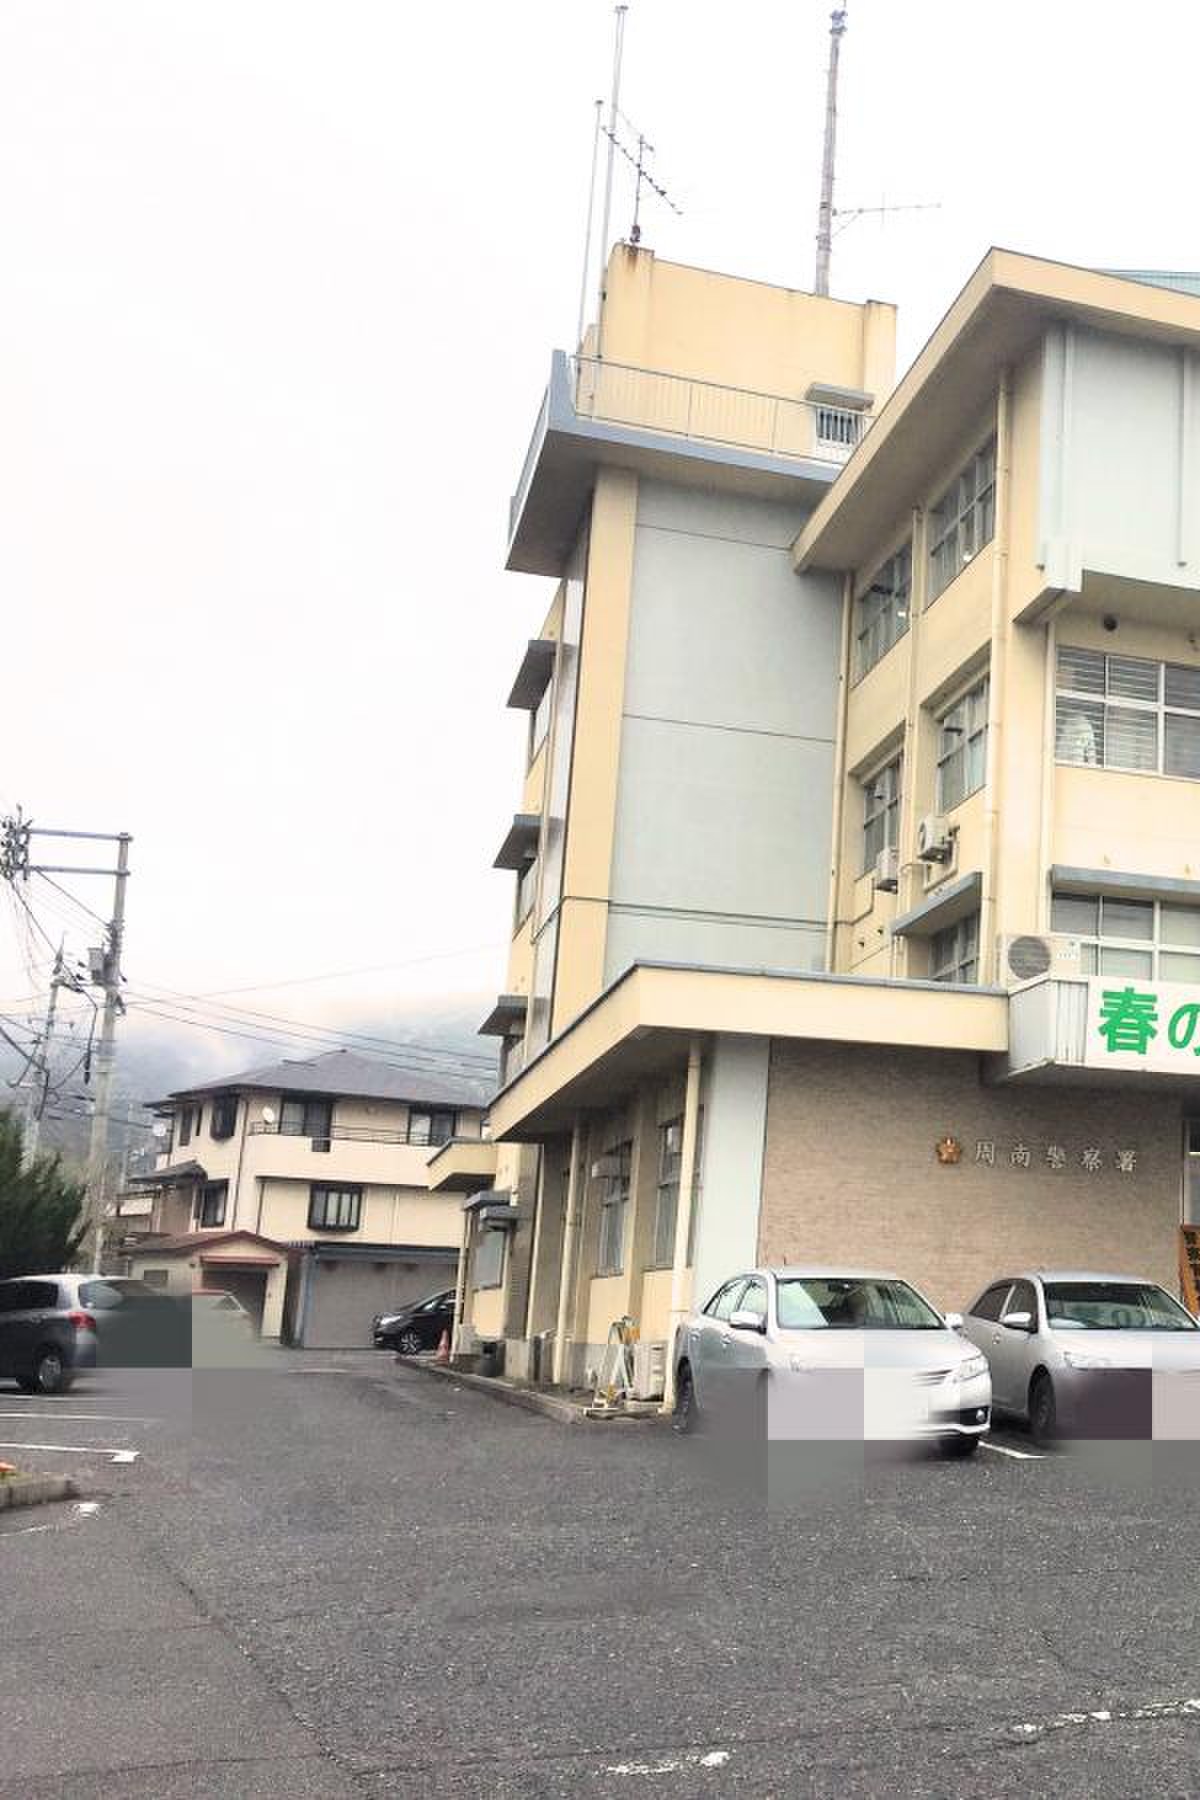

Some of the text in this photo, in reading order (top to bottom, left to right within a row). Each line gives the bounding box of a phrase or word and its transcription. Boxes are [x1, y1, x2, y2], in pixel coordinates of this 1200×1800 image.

[975, 1140, 1137, 1172] 周南警察署
